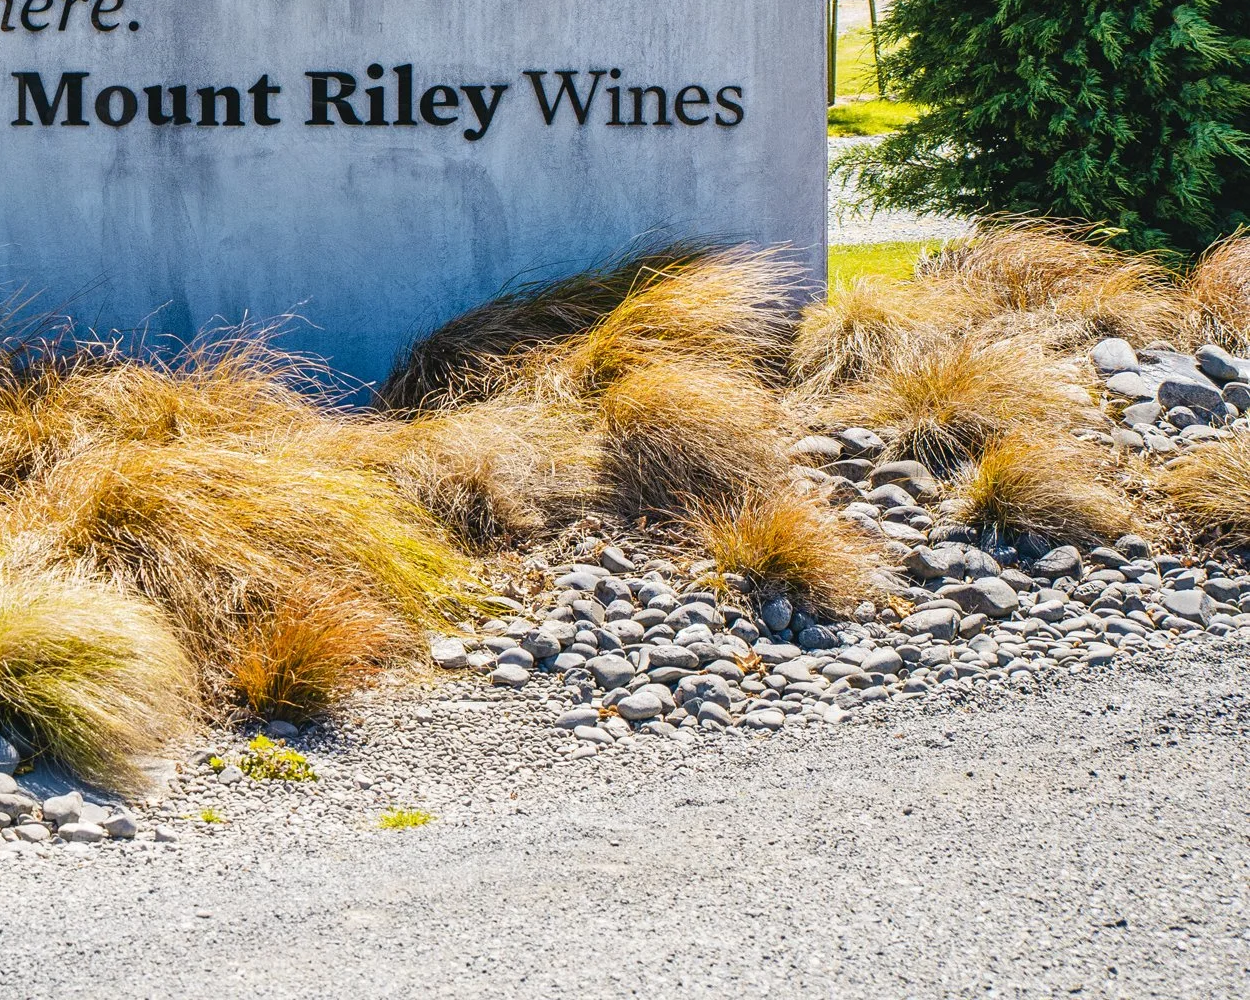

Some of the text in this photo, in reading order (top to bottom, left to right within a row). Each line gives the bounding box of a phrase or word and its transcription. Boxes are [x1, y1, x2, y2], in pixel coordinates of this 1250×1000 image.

[11, 72, 282, 130] Mount
[305, 64, 509, 142] Riley
[523, 68, 746, 127] Wines
